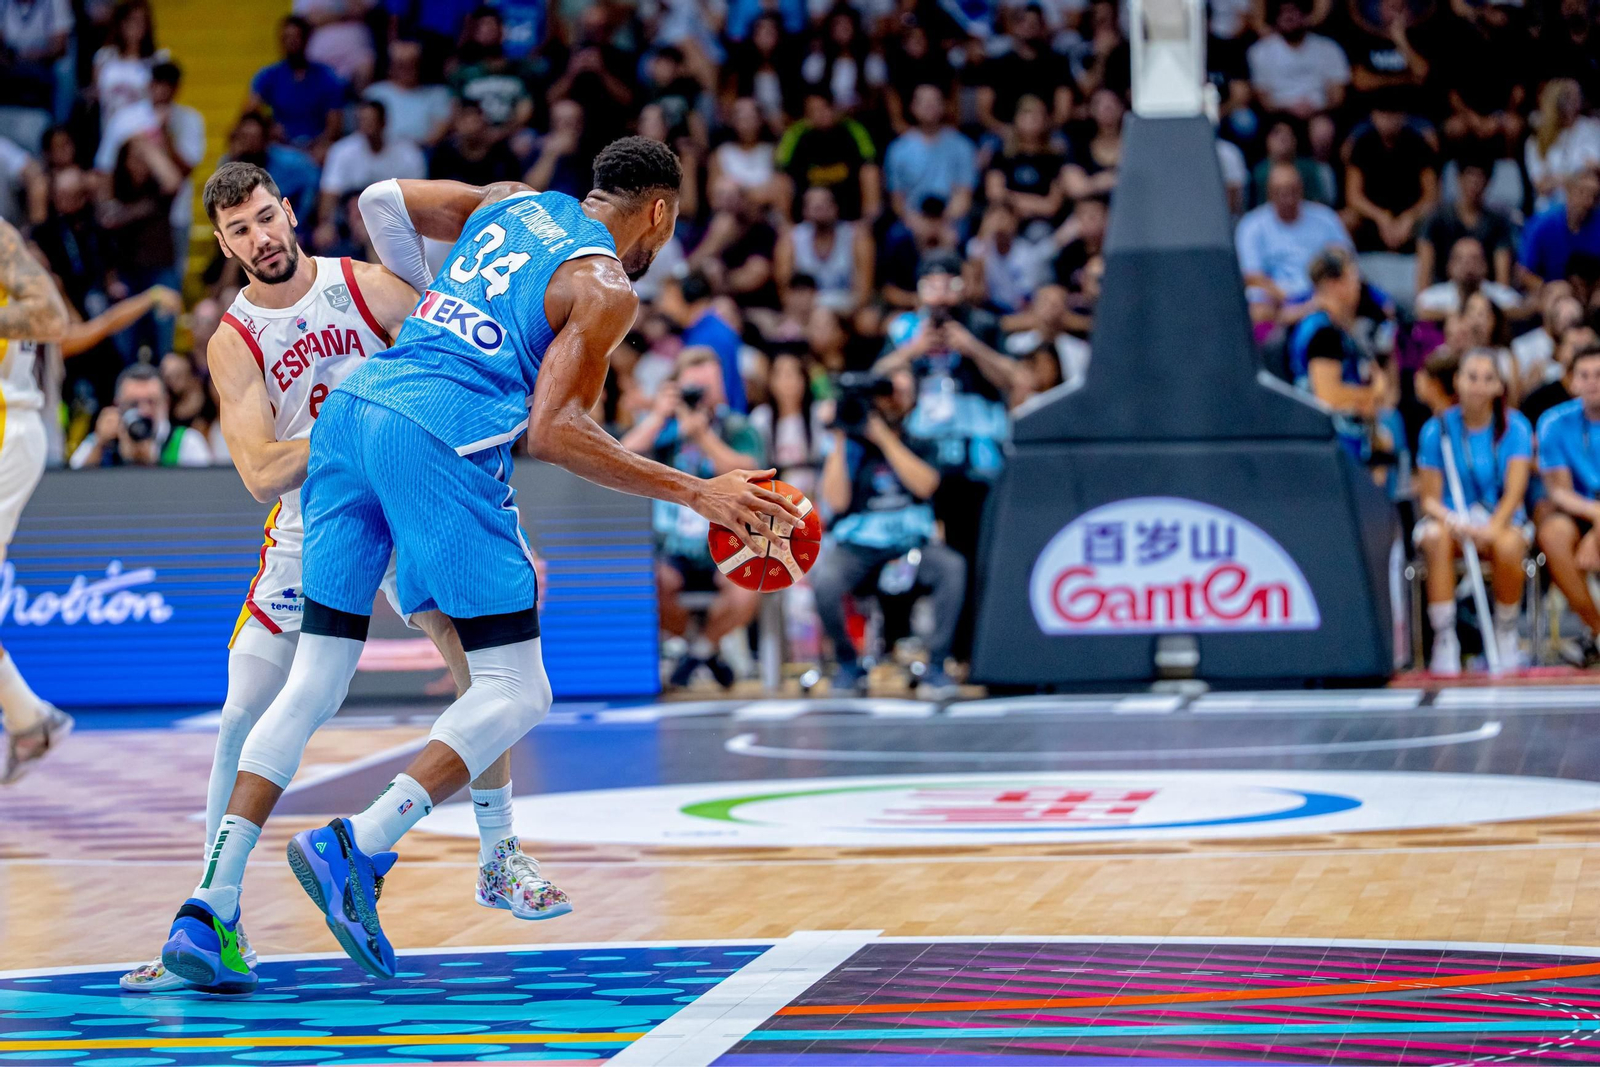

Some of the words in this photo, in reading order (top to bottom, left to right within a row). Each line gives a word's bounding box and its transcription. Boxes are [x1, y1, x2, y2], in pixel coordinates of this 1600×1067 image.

[450, 222, 532, 303] 34
[432, 298, 503, 350] EKO
[270, 324, 366, 393] ESPAÑA
[1083, 519, 1236, 566] 百岁山
